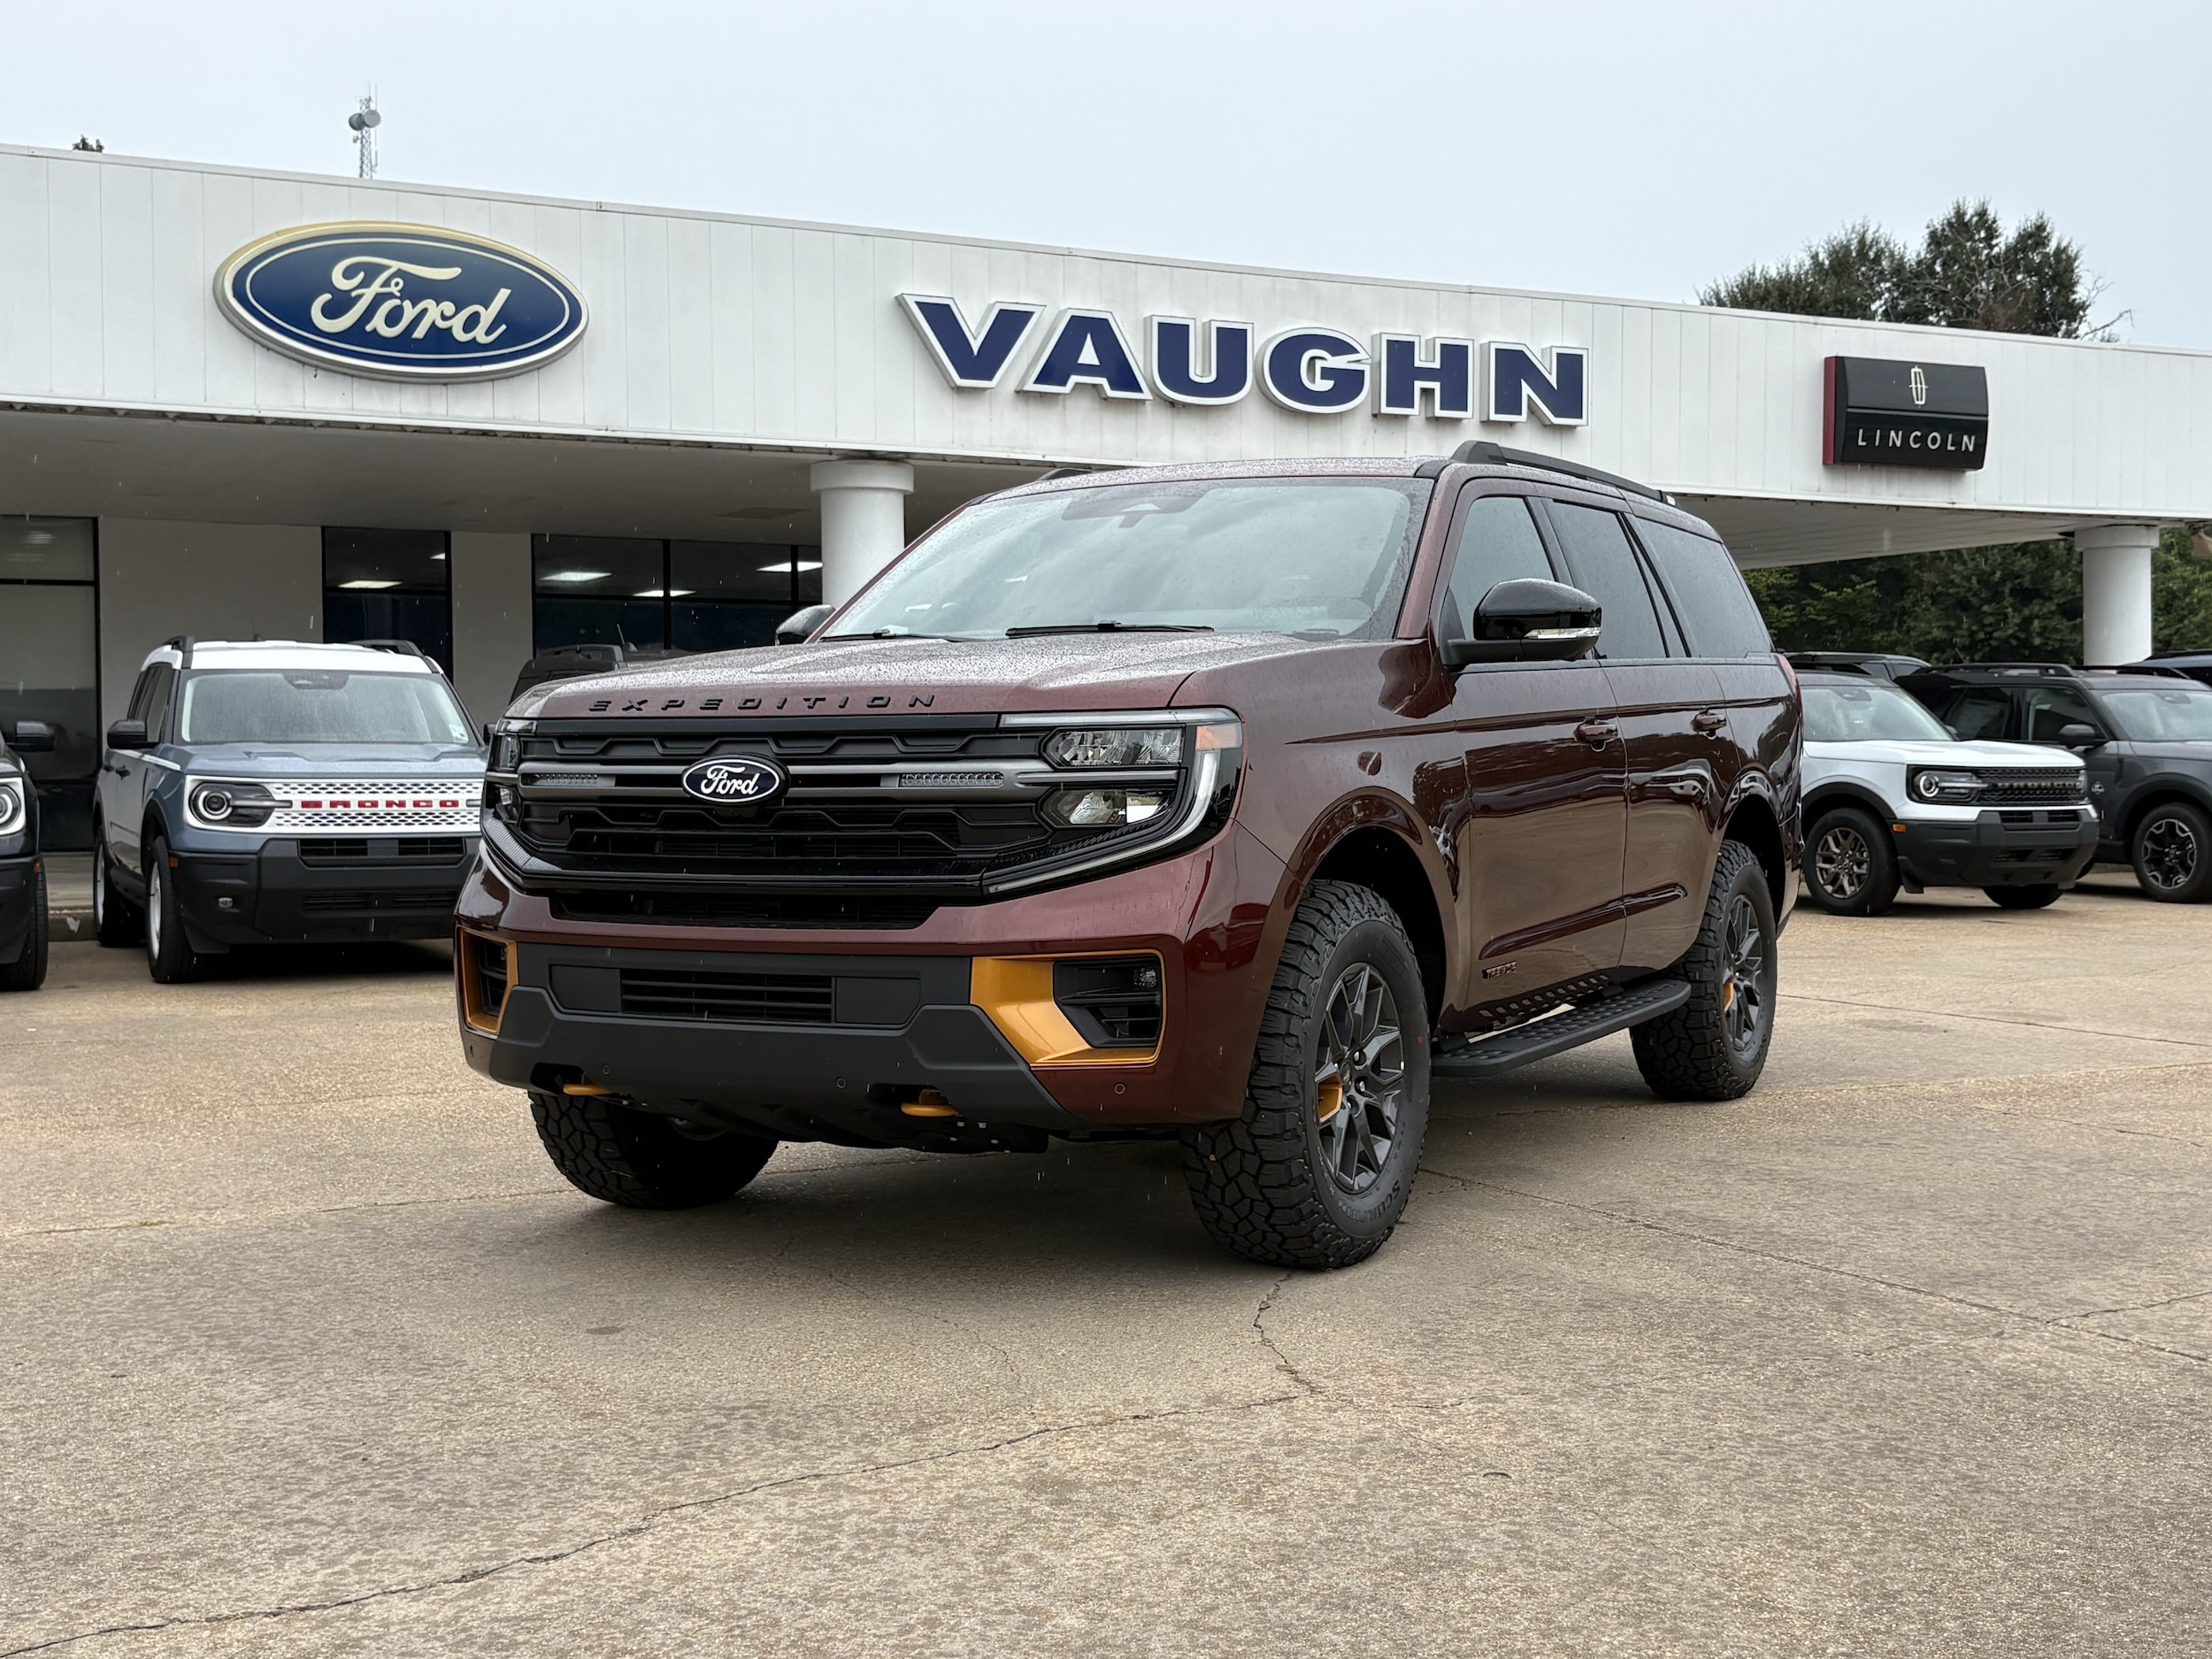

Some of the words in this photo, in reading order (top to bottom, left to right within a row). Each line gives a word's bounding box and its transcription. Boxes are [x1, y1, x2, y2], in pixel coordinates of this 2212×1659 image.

[311, 256, 511, 344] Ford
[896, 293, 1589, 428] VAUGHN
[1858, 428, 1976, 452] LINCOLN
[589, 694, 935, 711] EXPEDITION
[700, 764, 760, 796] Ford
[301, 800, 459, 809] BRONCO
